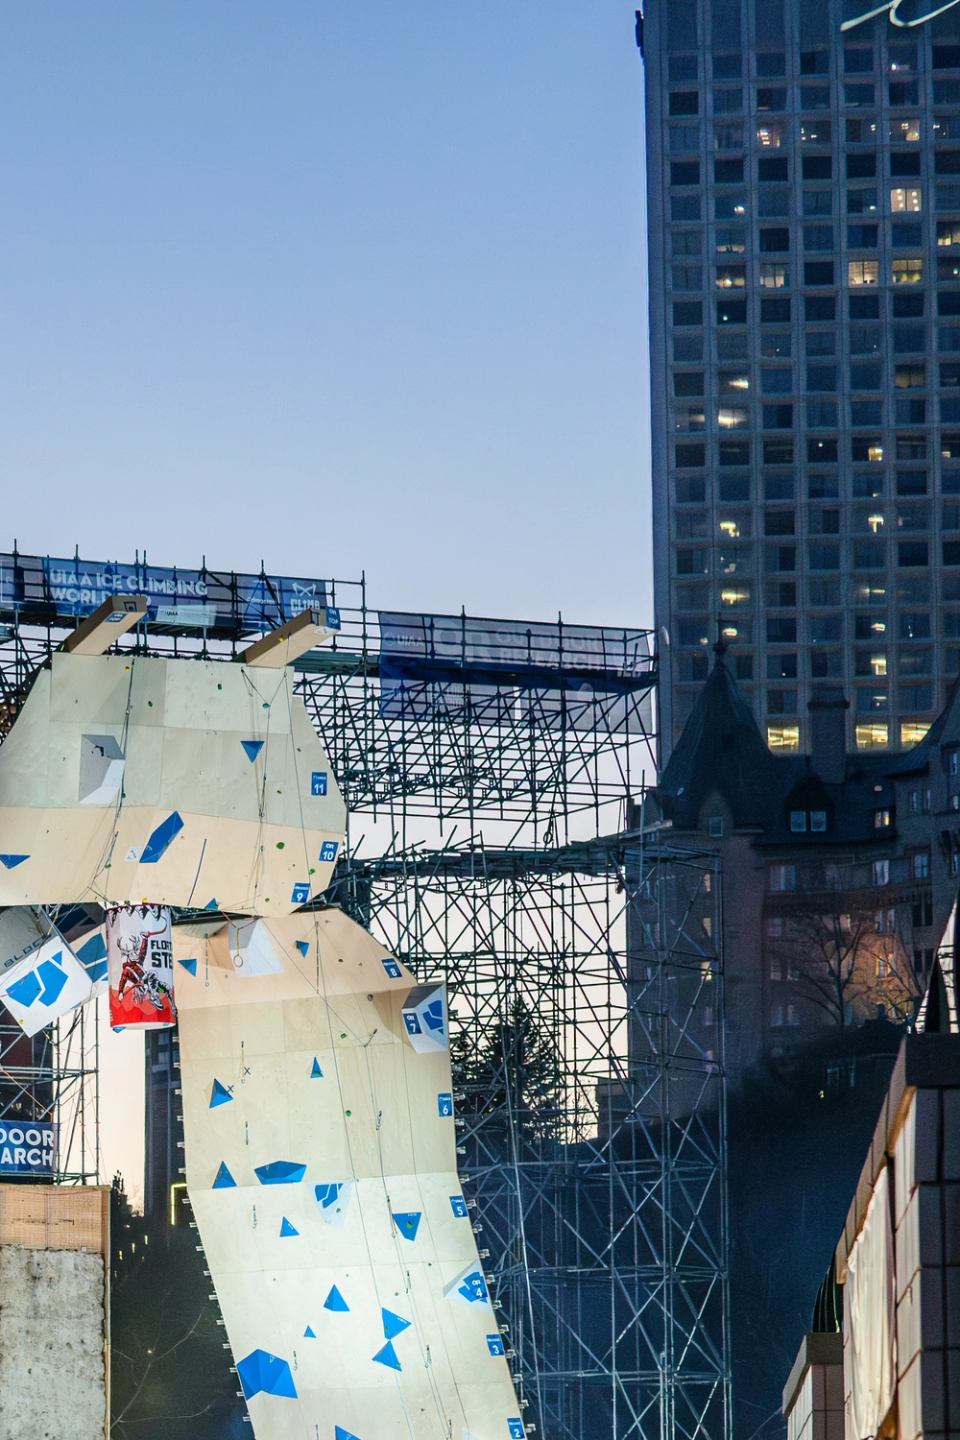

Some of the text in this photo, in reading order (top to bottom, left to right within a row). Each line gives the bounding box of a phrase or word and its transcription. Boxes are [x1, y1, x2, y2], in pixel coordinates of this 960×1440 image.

[50, 568, 208, 596] UIAA ICE CLIMBING
[314, 783, 324, 795] 11
[322, 851, 334, 861] 10
[296, 892, 303, 902] 9
[389, 966, 398, 977] 8
[409, 1023, 417, 1033] 7
[442, 1104, 449, 1115] 6
[456, 1206, 464, 1216] 5
[475, 1287, 483, 1297] 4
[492, 1344, 500, 1354] 3
[513, 1428, 521, 1438] 2
